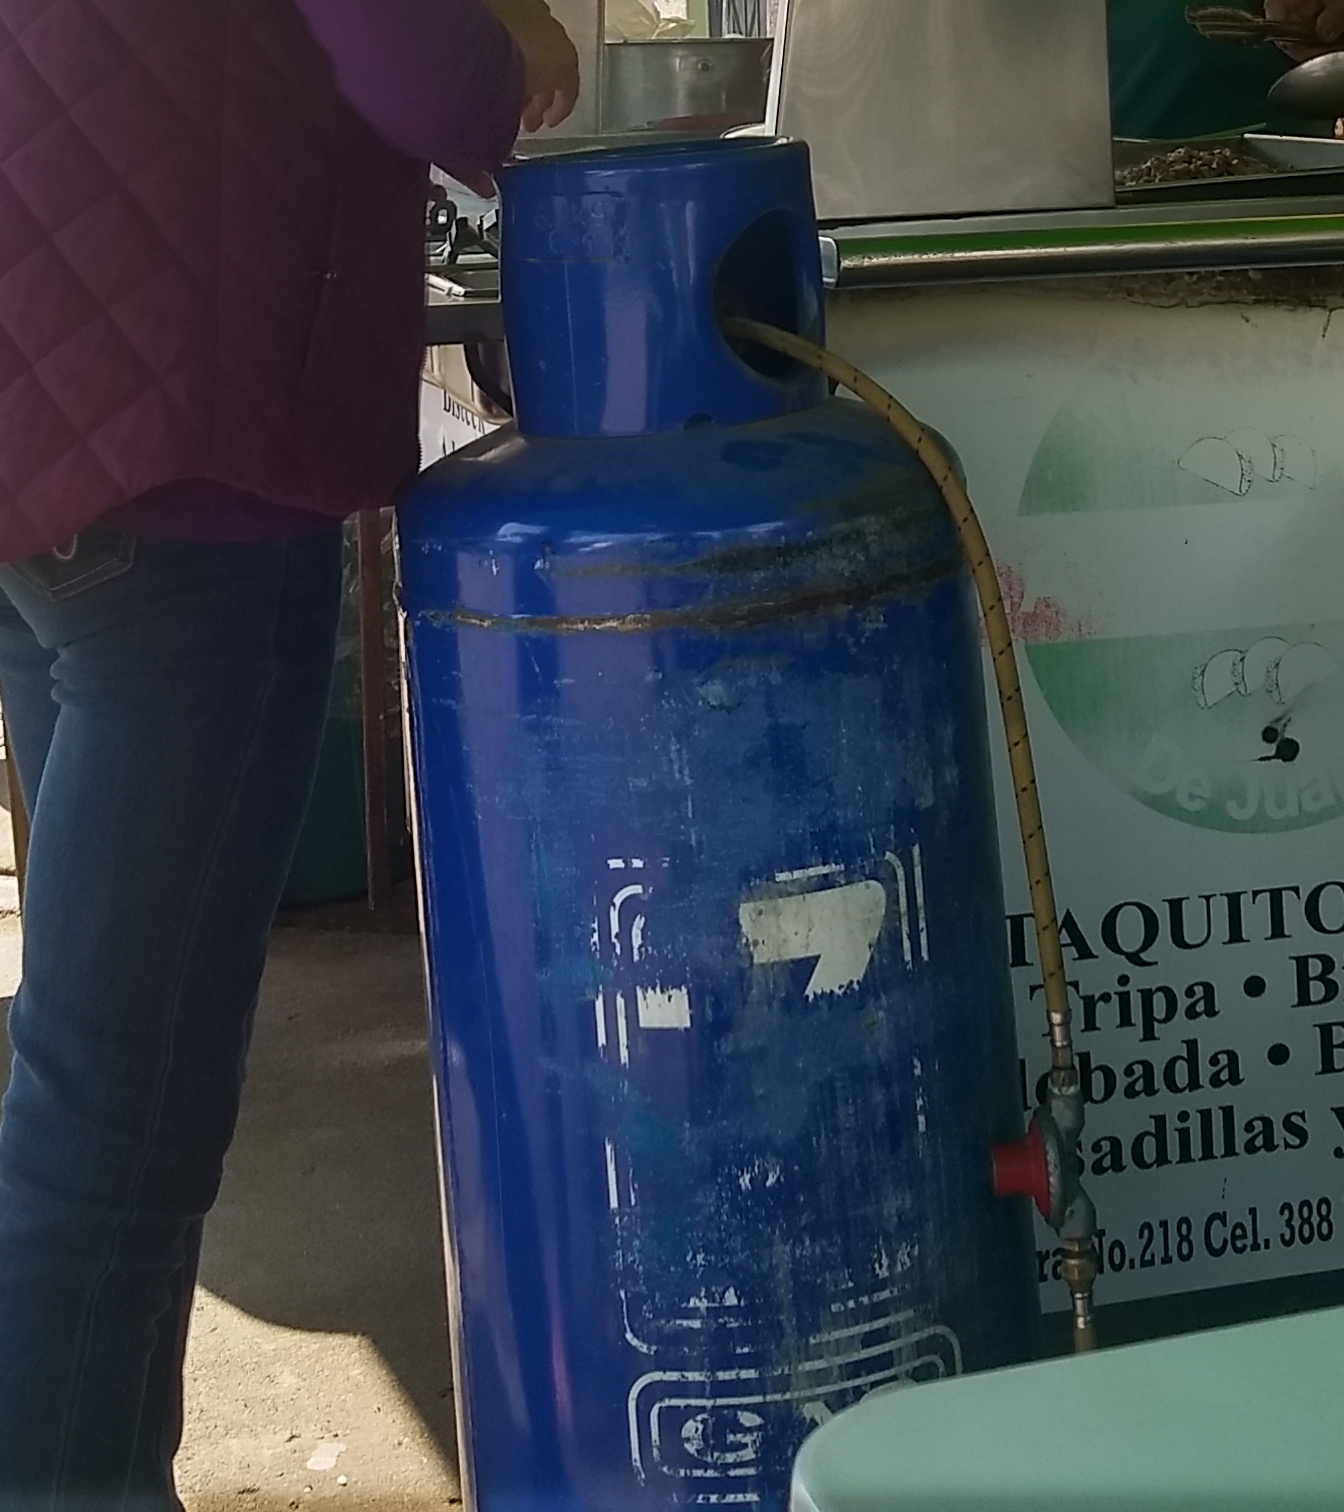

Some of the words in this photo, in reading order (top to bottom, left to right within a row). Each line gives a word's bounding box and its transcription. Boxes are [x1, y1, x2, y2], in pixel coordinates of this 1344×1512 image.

[1019, 1039, 1245, 1112] bada
[1204, 1207, 1271, 1258] Cel.
[1279, 1196, 1333, 1248] 388
